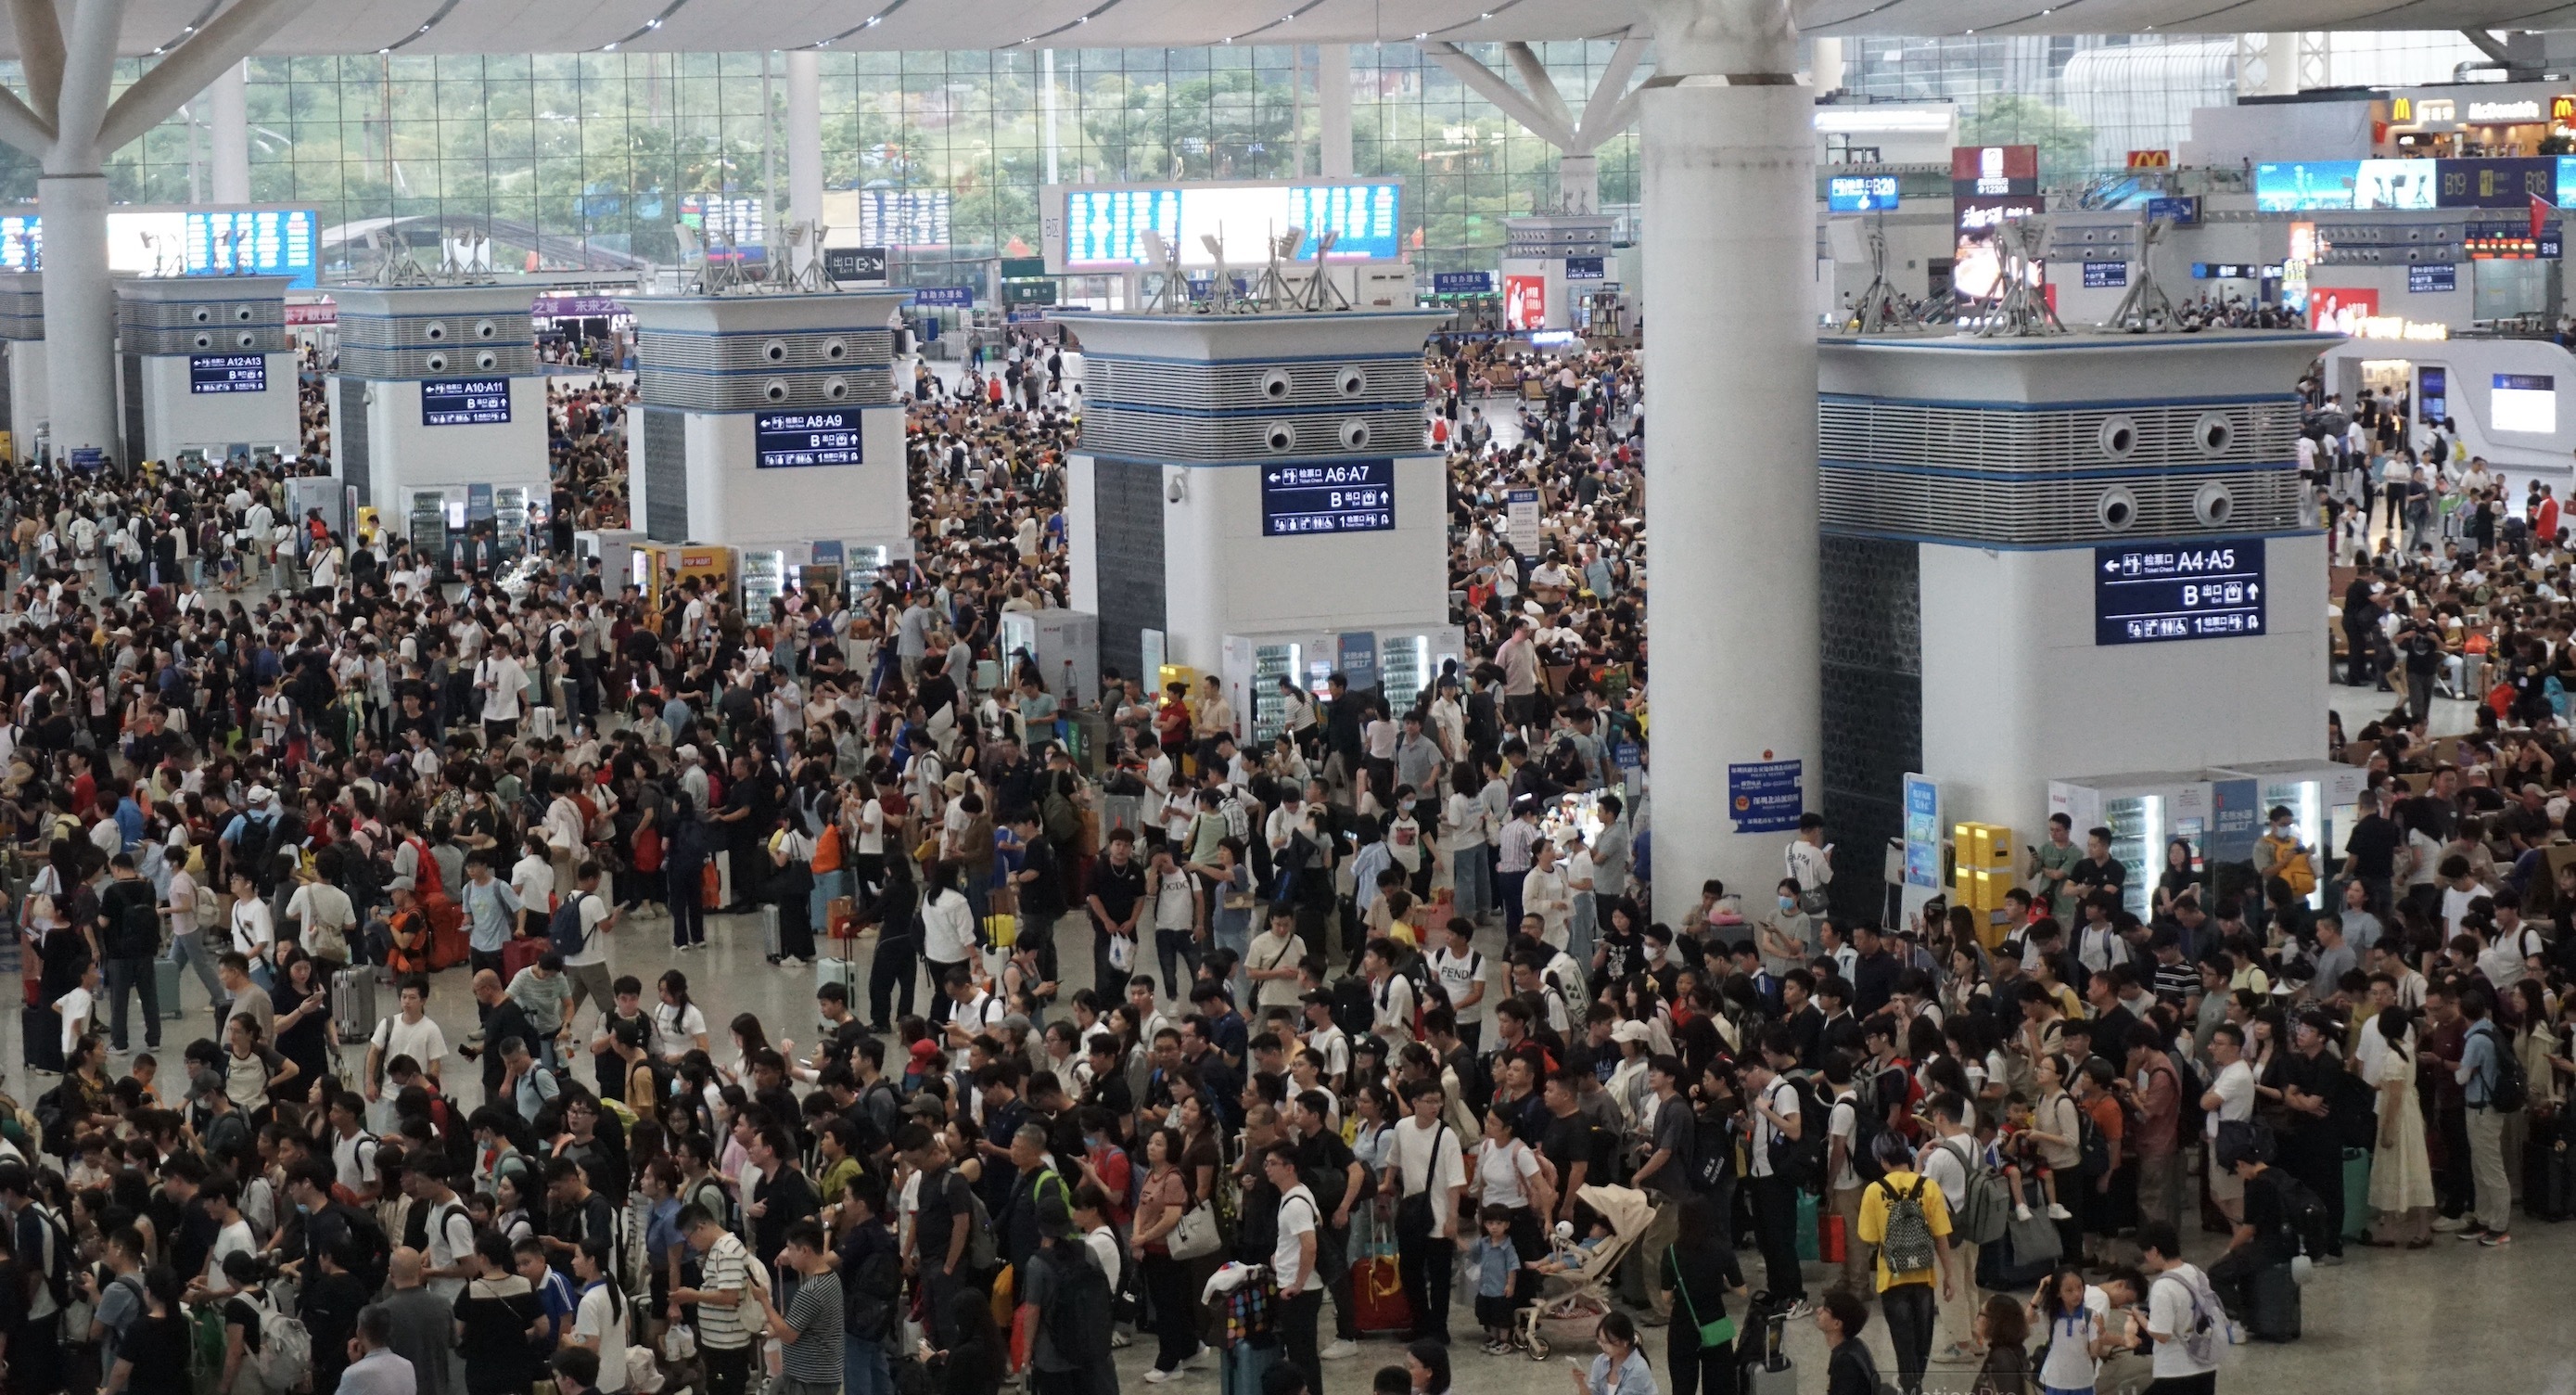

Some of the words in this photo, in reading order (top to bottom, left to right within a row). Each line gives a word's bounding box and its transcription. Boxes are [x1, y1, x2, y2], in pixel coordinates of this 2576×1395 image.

[1873, 178, 1895, 196] B20
[2445, 173, 2466, 196] B19
[2525, 171, 2547, 194] B18
[1046, 218, 1059, 237] B区
[834, 257, 853, 267] 出口
[1442, 275, 1482, 284] 自助办理处
[921, 289, 963, 299] 自助办理处
[531, 301, 558, 314] 之城
[229, 371, 236, 379] B
[465, 382, 503, 392] A10·A11
[467, 399, 476, 409] B
[806, 415, 842, 428] A8·A9
[810, 435, 820, 447] B
[818, 454, 823, 463] 1
[1299, 468, 1322, 478] 检票口
[1325, 466, 1369, 482] A6·A7
[1331, 492, 1342, 507] B
[1345, 492, 1360, 501] 出口
[1340, 516, 1345, 528] 1
[1346, 515, 1365, 523] 检票口
[683, 557, 695, 566] POP
[2144, 554, 2174, 566] 检票口
[2177, 549, 2235, 571] A4·A5
[2184, 585, 2199, 606] B
[2202, 584, 2222, 596] 出口
[2195, 618, 2202, 634] 1
[2204, 617, 2227, 626] 检票口
